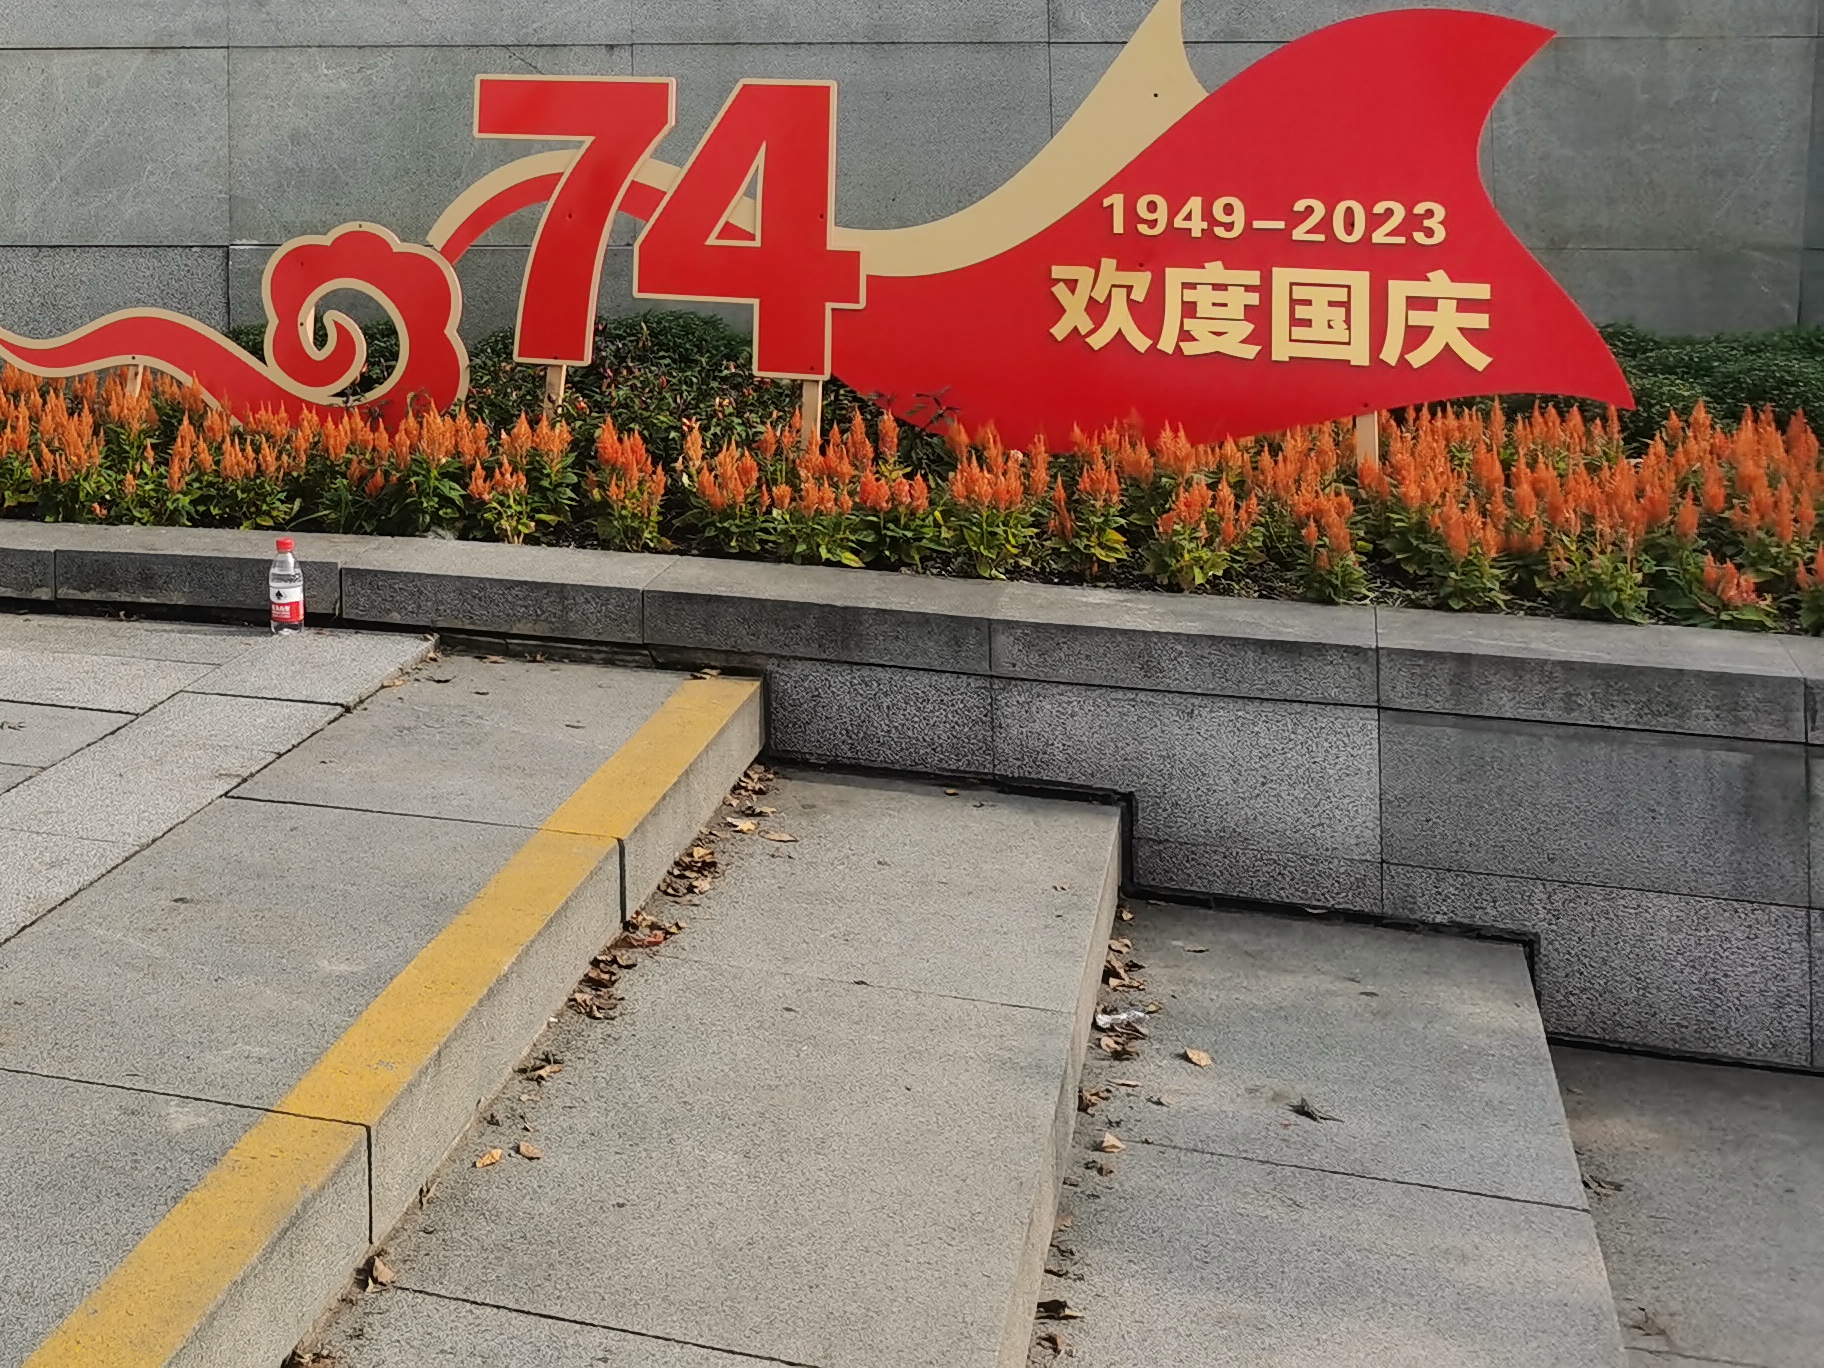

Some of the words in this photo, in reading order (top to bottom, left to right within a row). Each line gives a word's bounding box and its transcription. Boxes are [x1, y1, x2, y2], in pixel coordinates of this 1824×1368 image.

[474, 74, 866, 380] 74
[1100, 192, 1448, 247] 1949-2023
[1049, 260, 1494, 372] 欢度国庆
